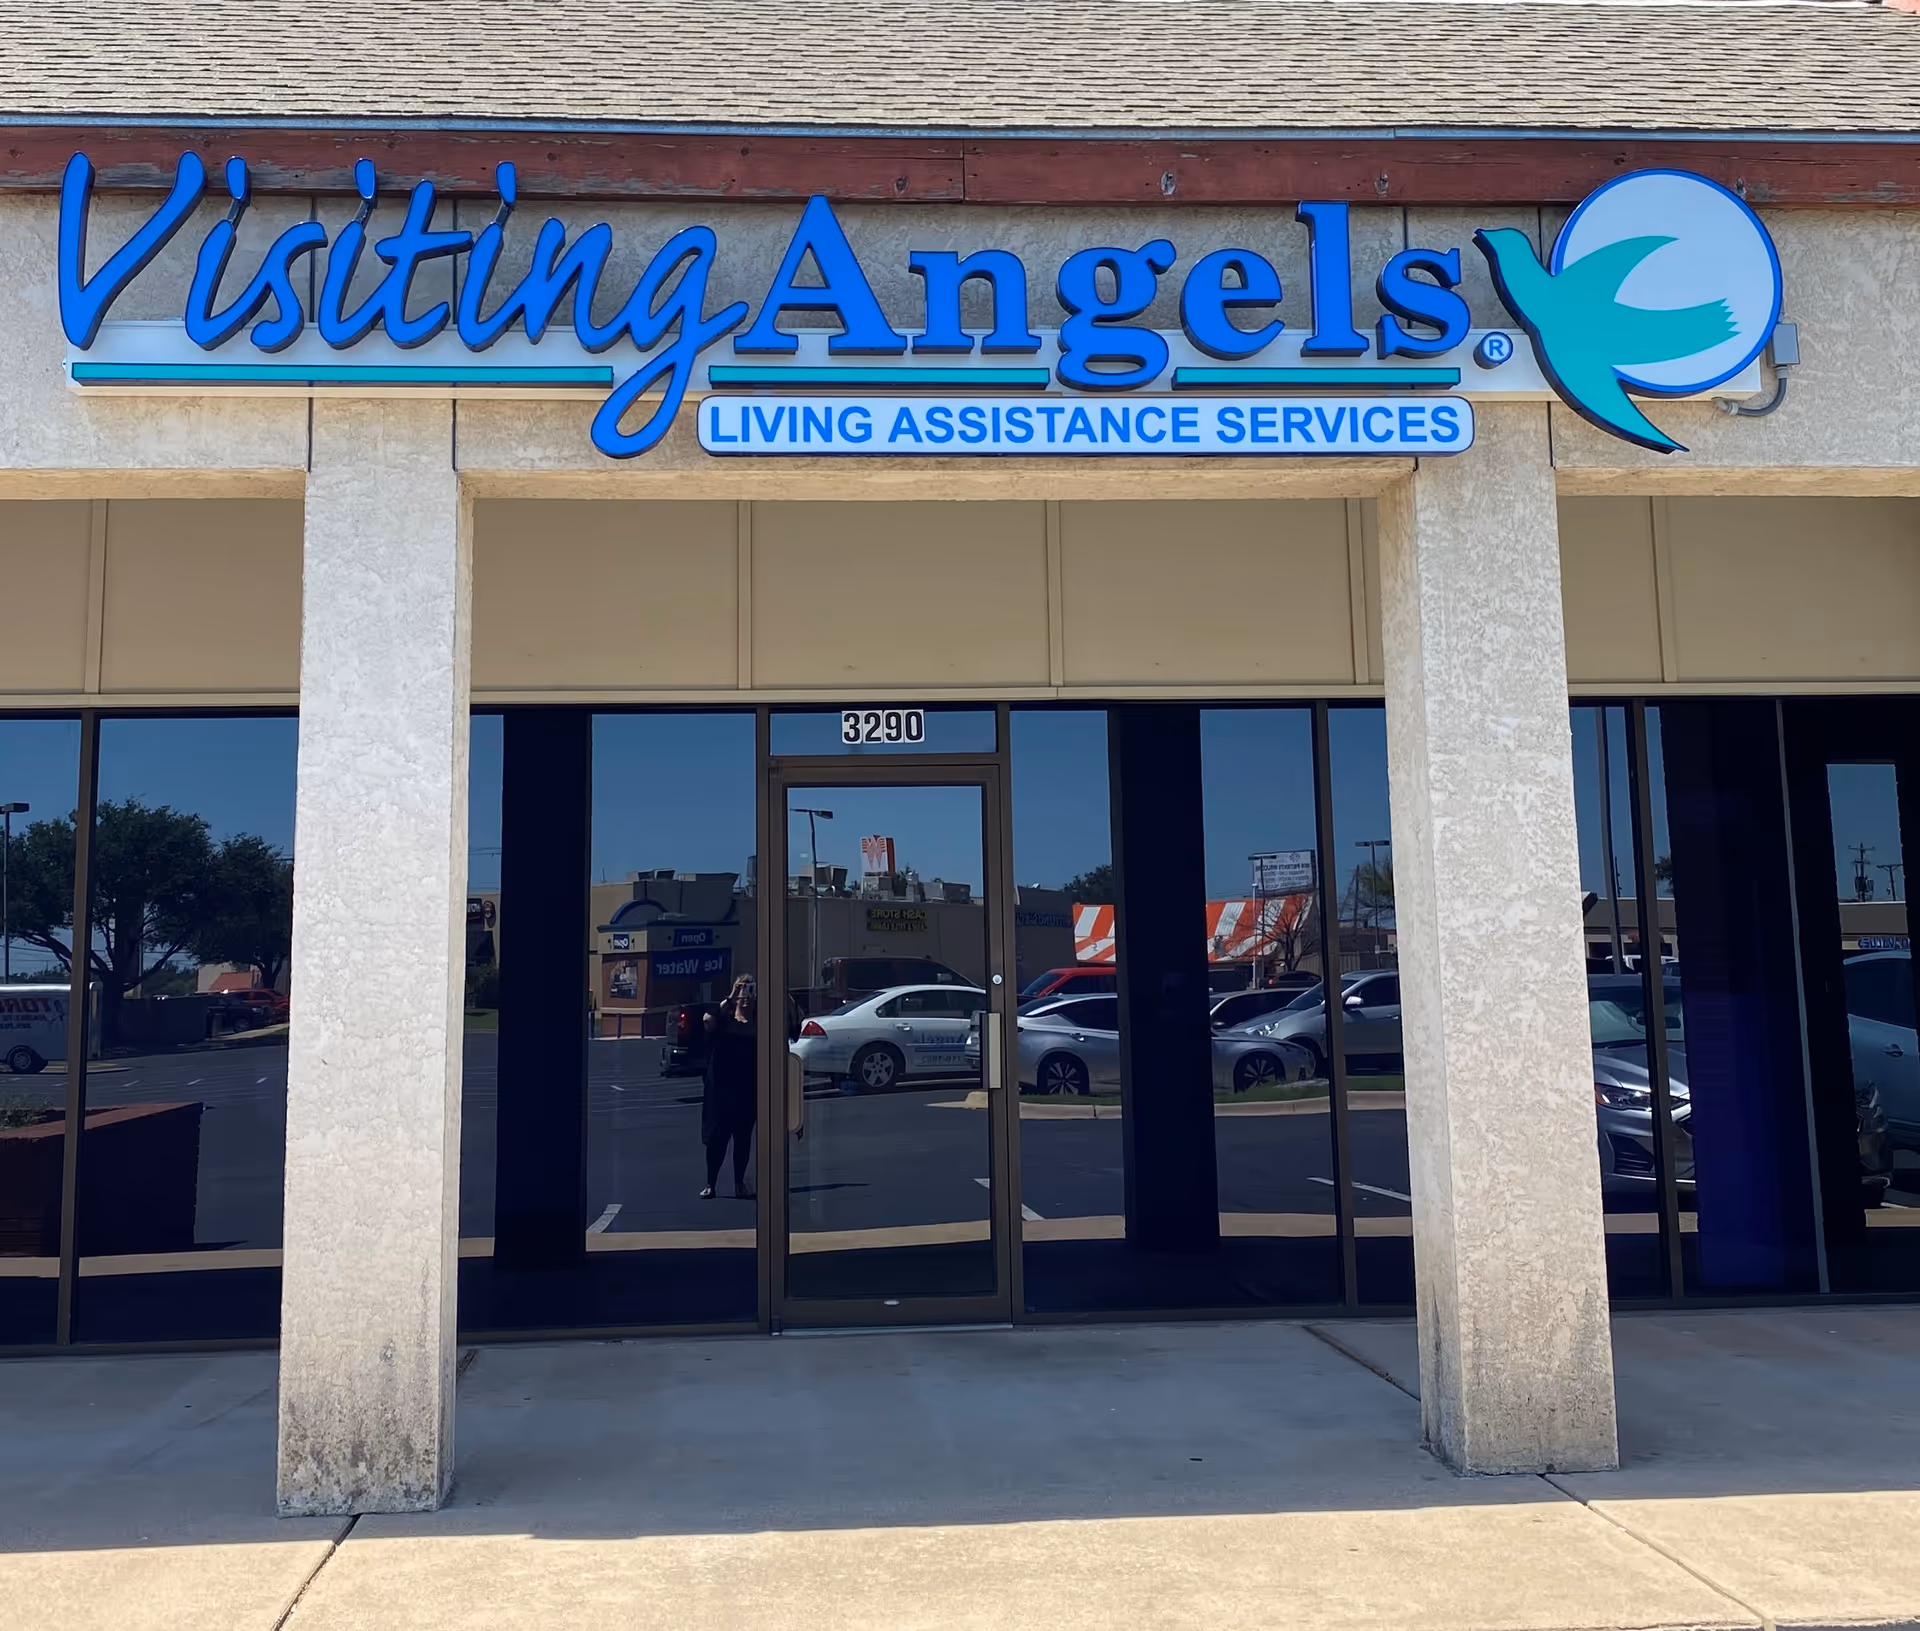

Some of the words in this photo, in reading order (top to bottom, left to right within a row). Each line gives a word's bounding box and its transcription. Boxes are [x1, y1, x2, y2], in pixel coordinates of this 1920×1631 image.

[58, 151, 749, 457] Visiting
[731, 194, 1473, 391] Angels
[709, 404, 873, 443] LIVING
[889, 404, 1201, 444] ASSISTANCE
[1216, 404, 1461, 443] SERVICES
[843, 710, 924, 742] 3290
